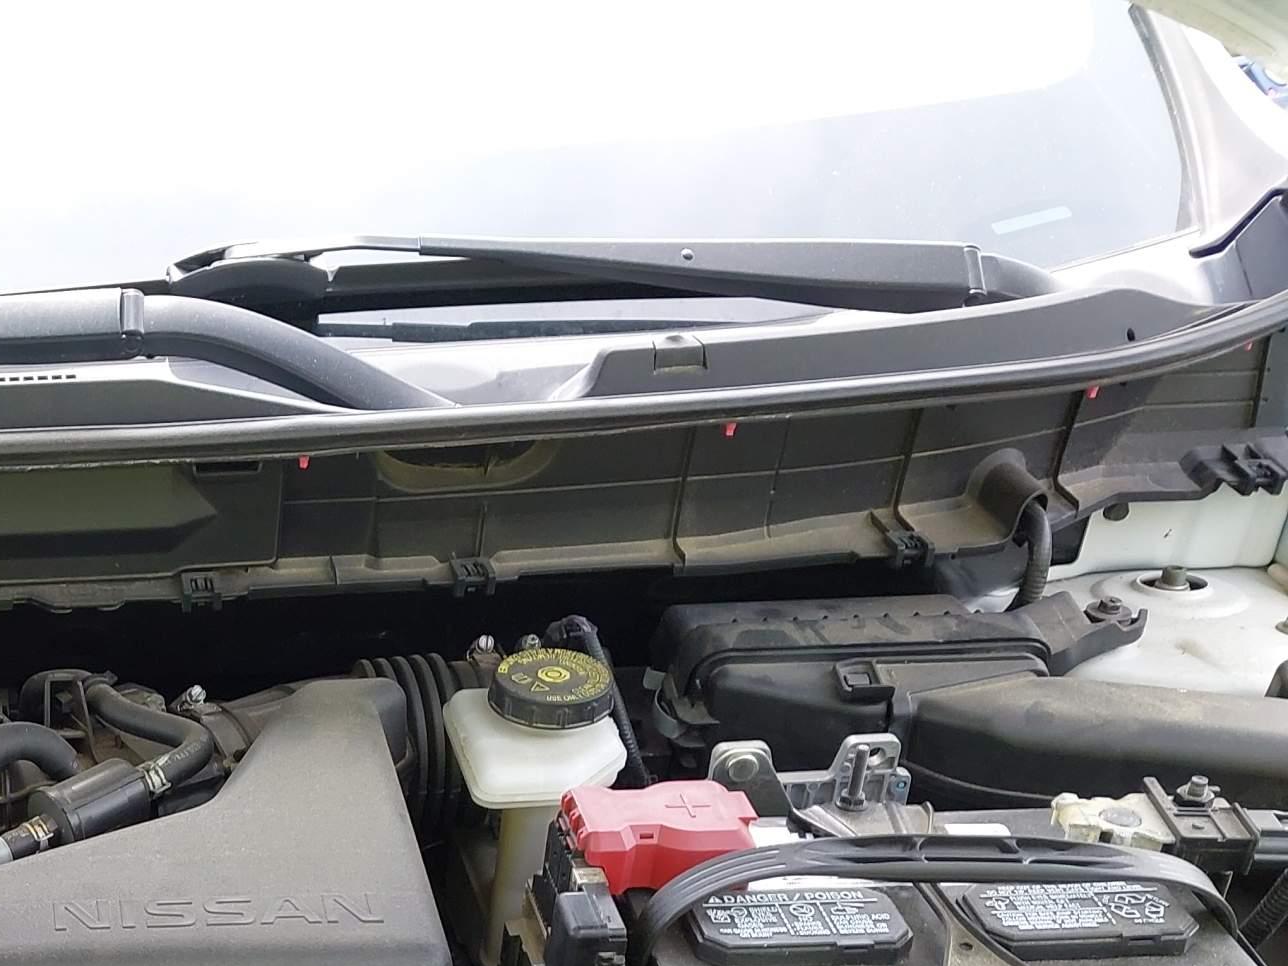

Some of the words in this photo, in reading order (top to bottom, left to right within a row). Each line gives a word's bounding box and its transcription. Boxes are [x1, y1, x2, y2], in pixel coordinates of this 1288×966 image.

[723, 894, 788, 903] DANGER
[805, 891, 864, 901] POISON
[52, 892, 385, 932] NISSAN
